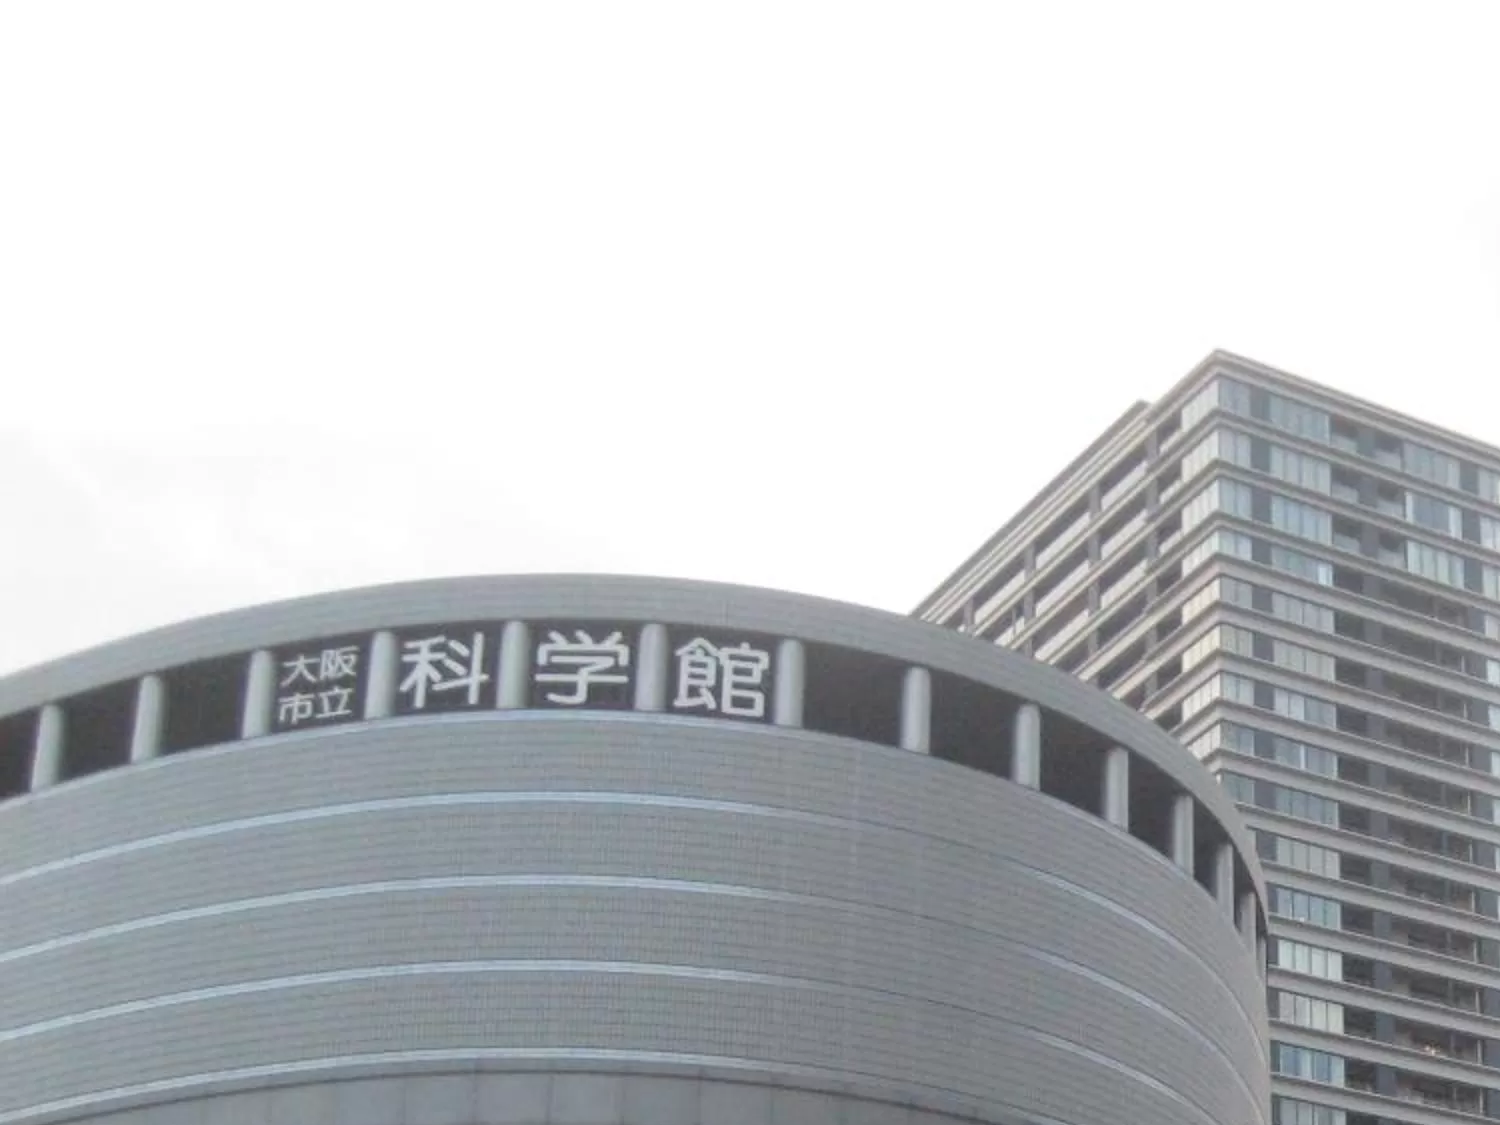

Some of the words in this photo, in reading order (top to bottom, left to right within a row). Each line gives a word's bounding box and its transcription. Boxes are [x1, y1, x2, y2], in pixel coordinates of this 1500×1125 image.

[280, 645, 360, 687] 大阪
[399, 629, 770, 718] 科学館
[278, 686, 354, 725] 市立
